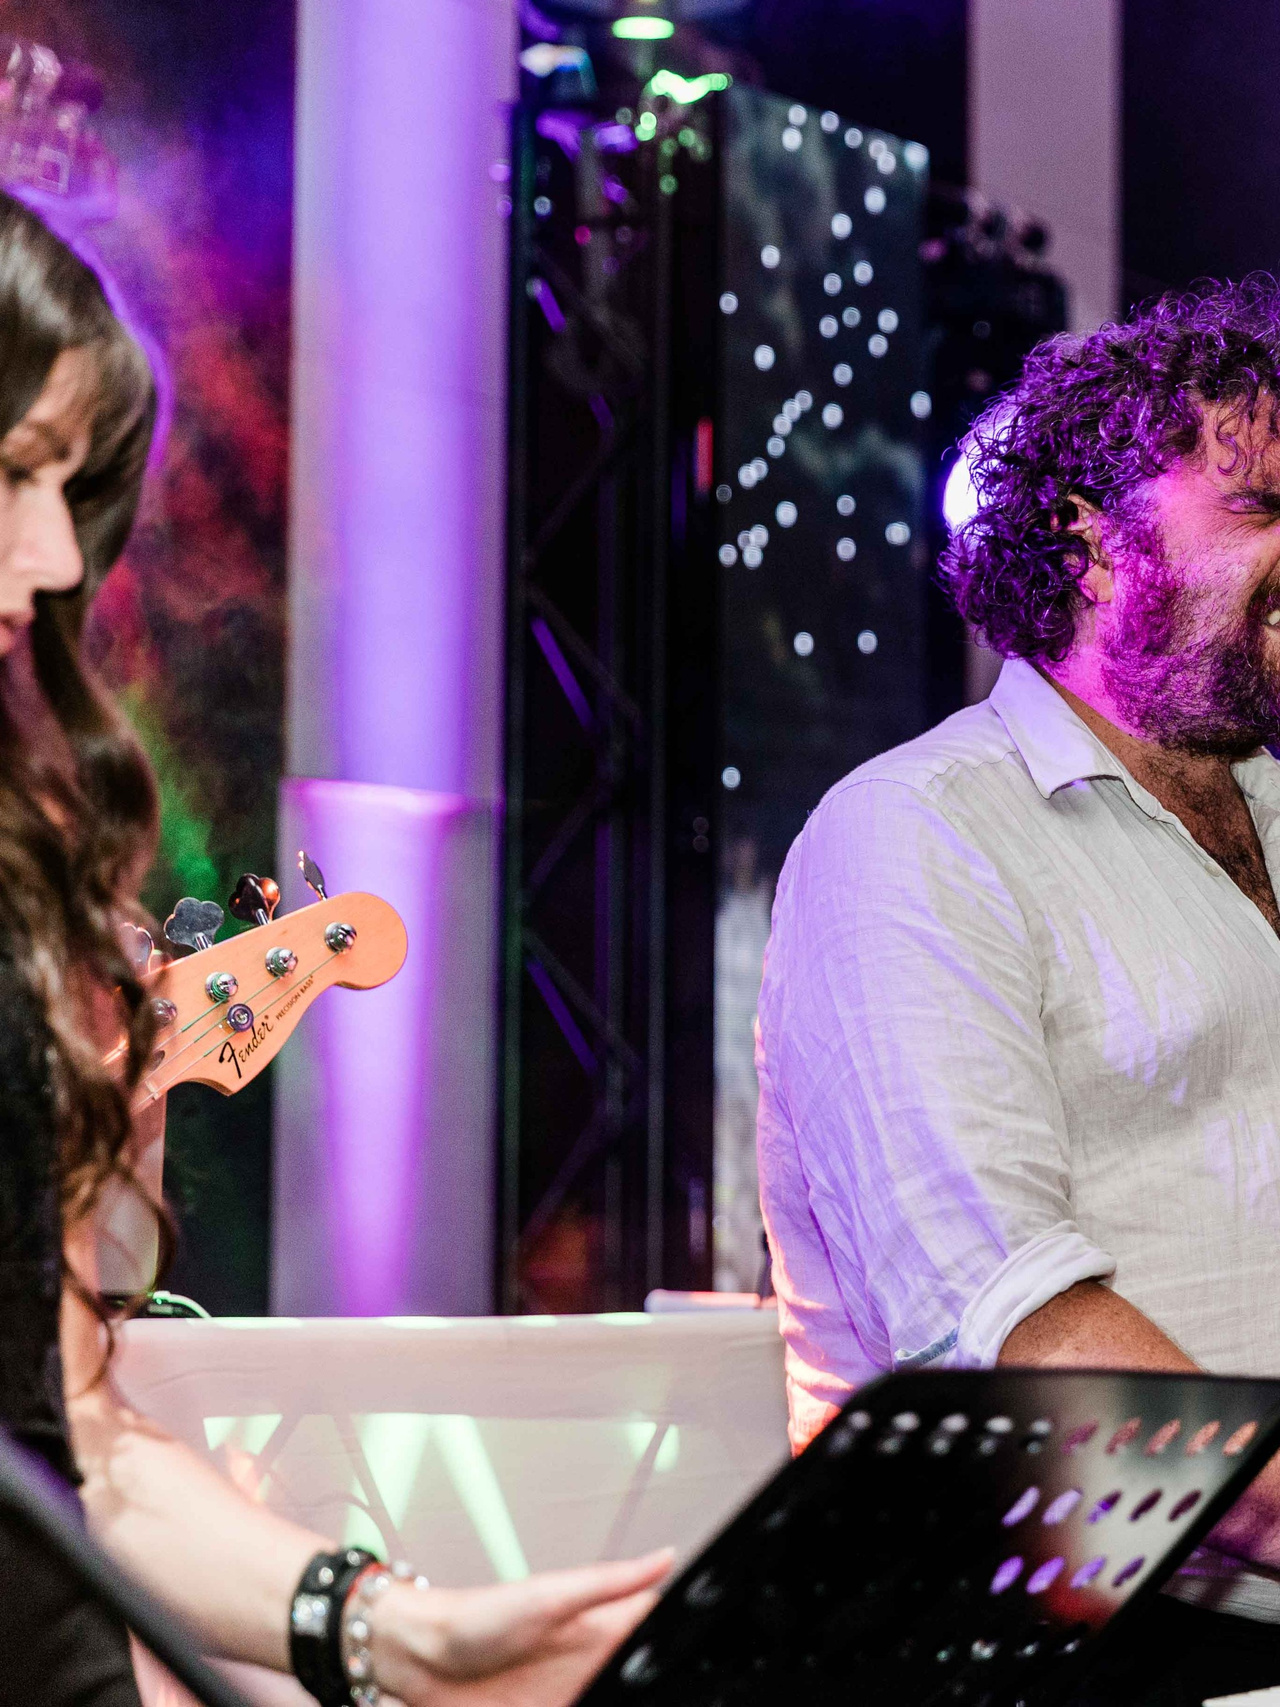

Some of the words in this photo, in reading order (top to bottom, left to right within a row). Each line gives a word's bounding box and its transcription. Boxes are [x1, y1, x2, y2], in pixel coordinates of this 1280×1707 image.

[275, 991, 301, 1020] PRECISION
[300, 979, 314, 994] BASS
[218, 1021, 275, 1080] Fender
